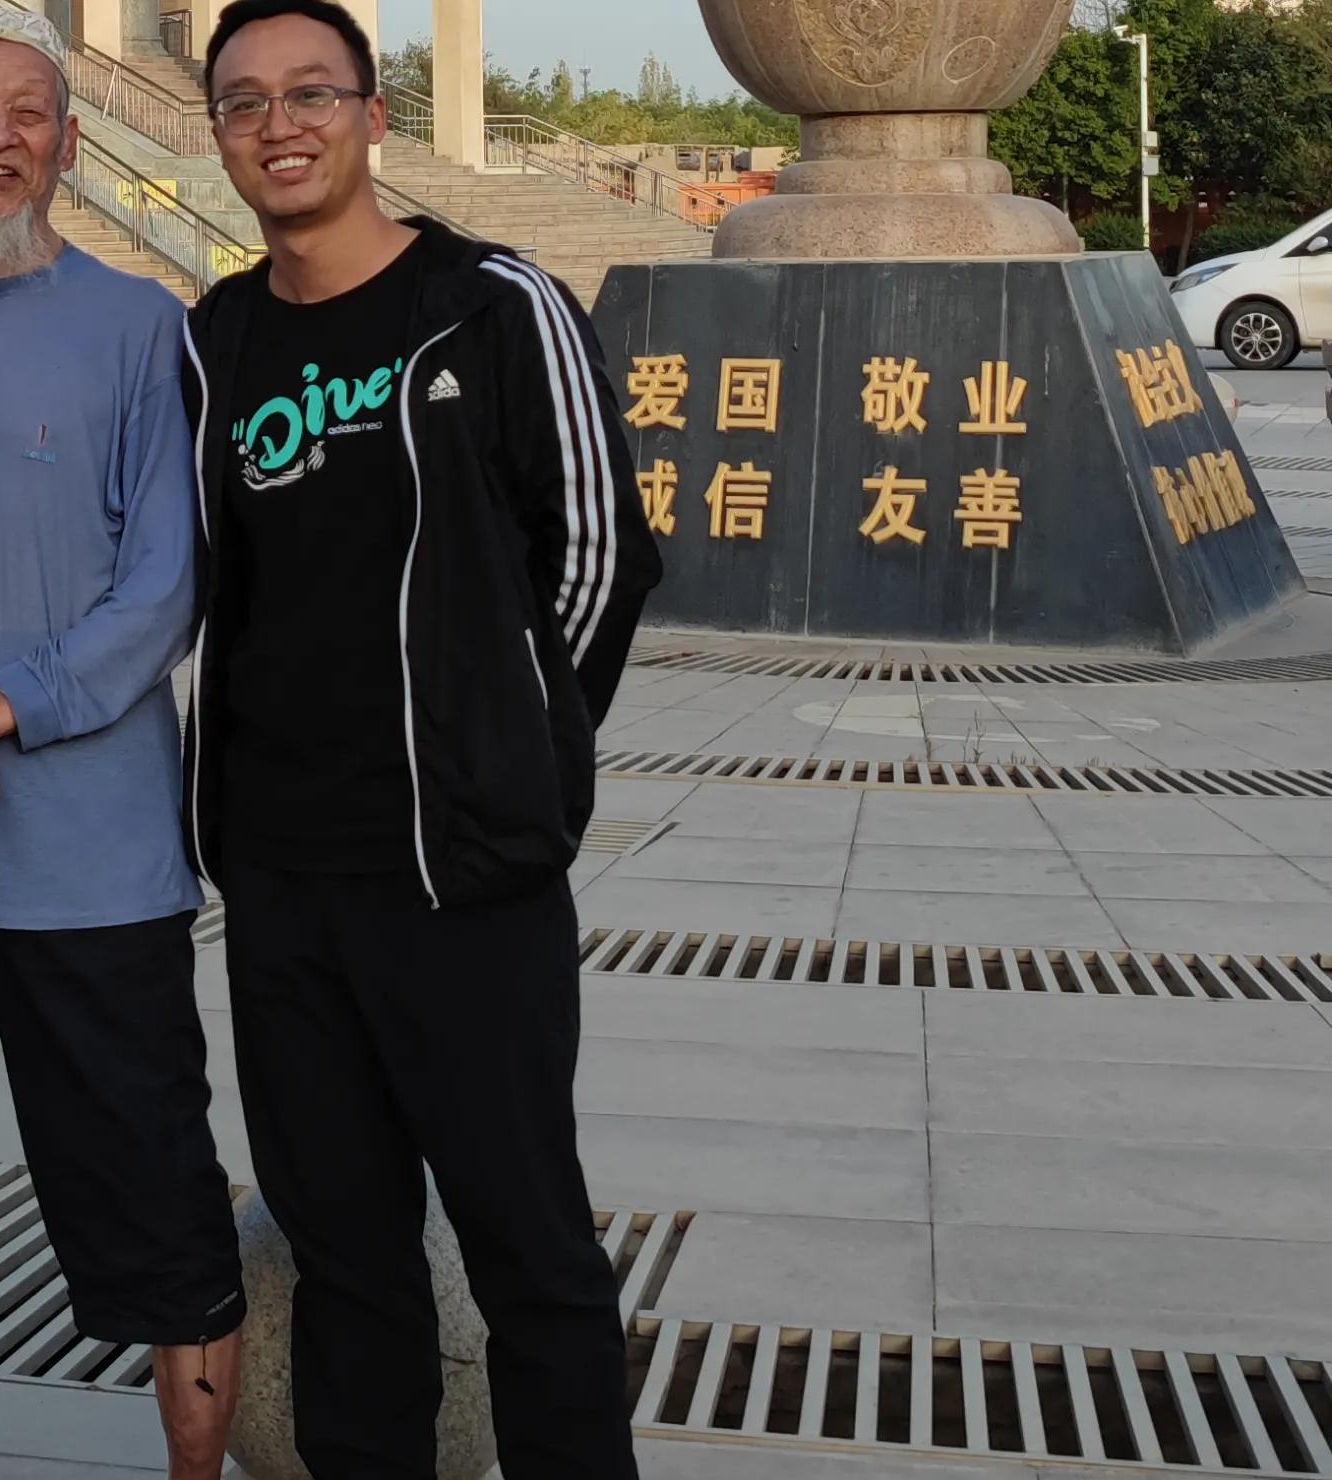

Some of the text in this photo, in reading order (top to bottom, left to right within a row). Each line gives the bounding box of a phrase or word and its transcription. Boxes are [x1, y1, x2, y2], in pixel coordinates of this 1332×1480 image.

[623, 354, 1028, 435] 爱国 敬业
[858, 466, 1022, 549] 友善
